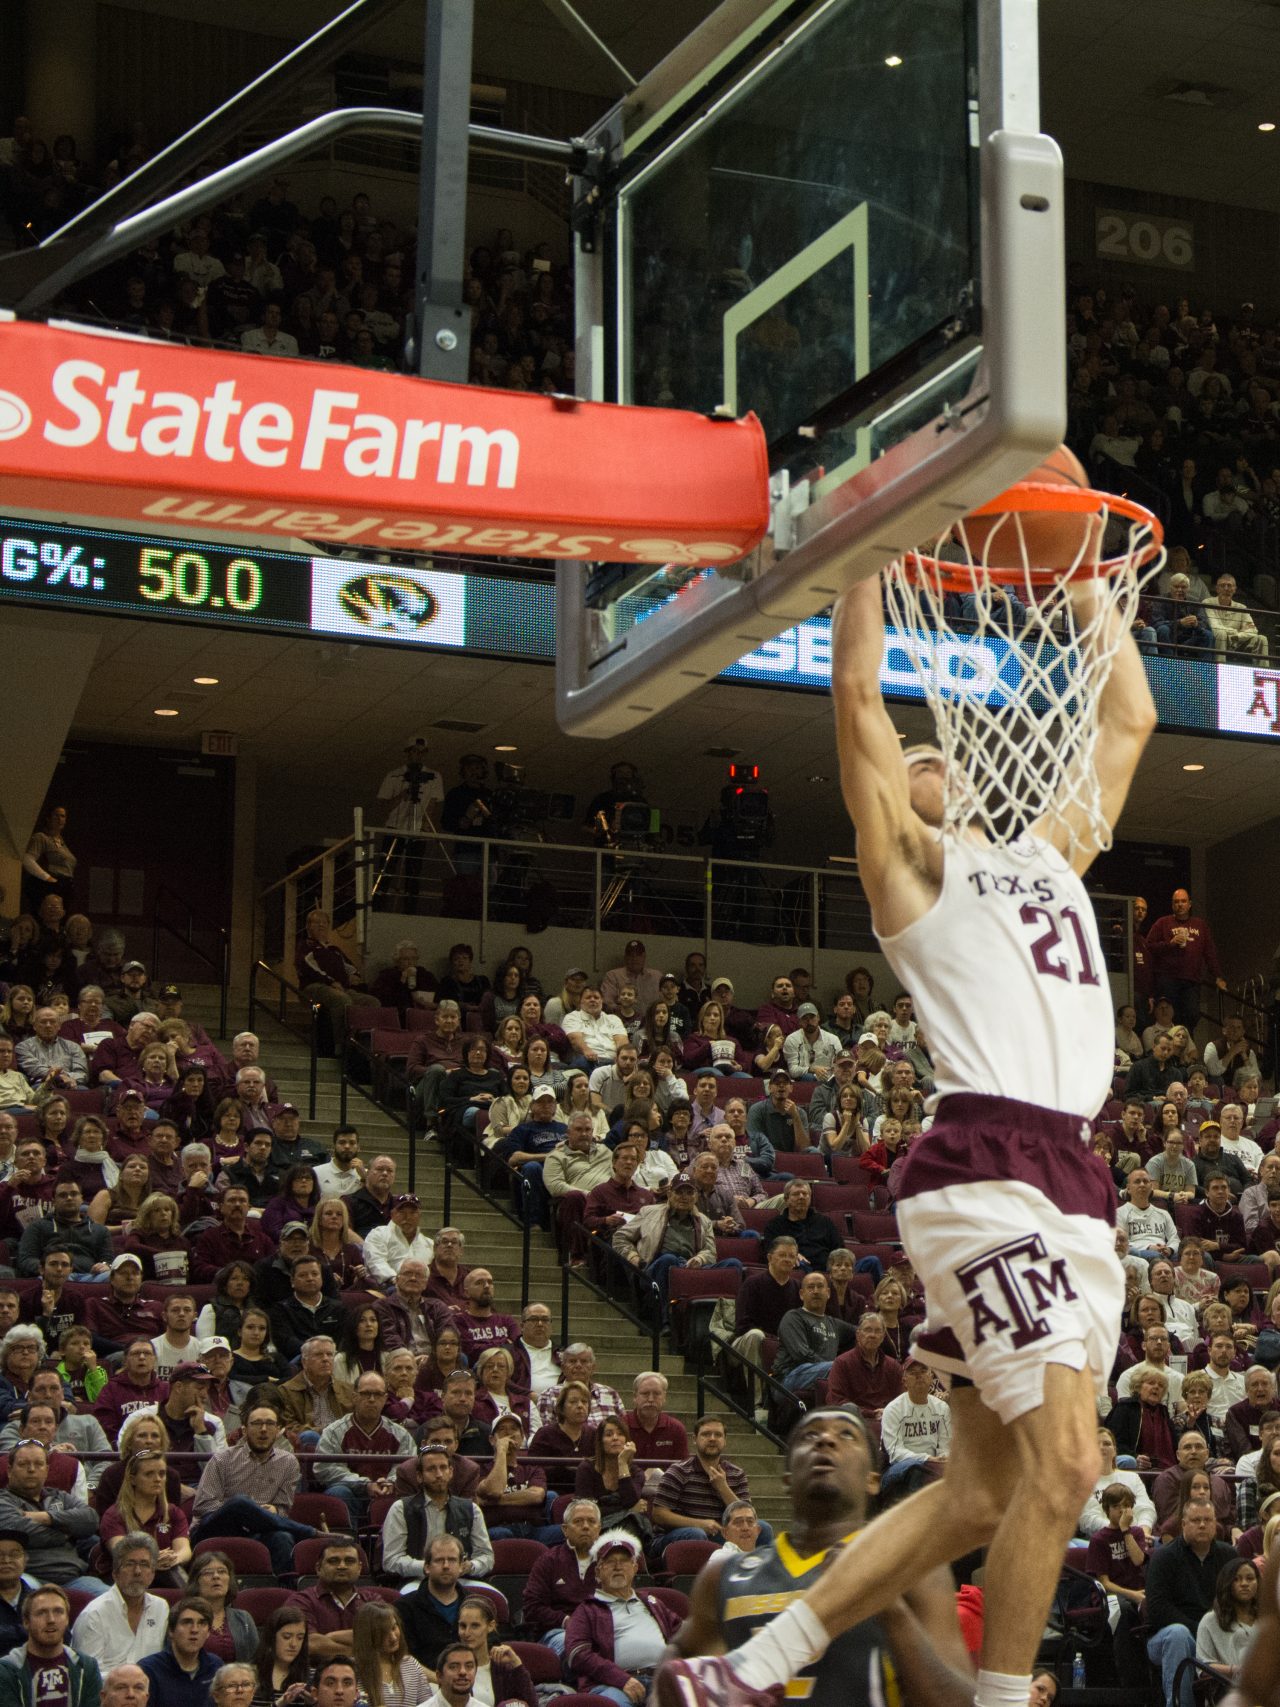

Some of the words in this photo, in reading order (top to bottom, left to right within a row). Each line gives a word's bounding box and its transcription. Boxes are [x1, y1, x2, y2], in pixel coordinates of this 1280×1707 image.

[1096, 215, 1194, 268] 206
[139, 547, 263, 611] 50.0
[1019, 899, 1101, 986] 21
[904, 1421, 928, 1437] TEXAS
